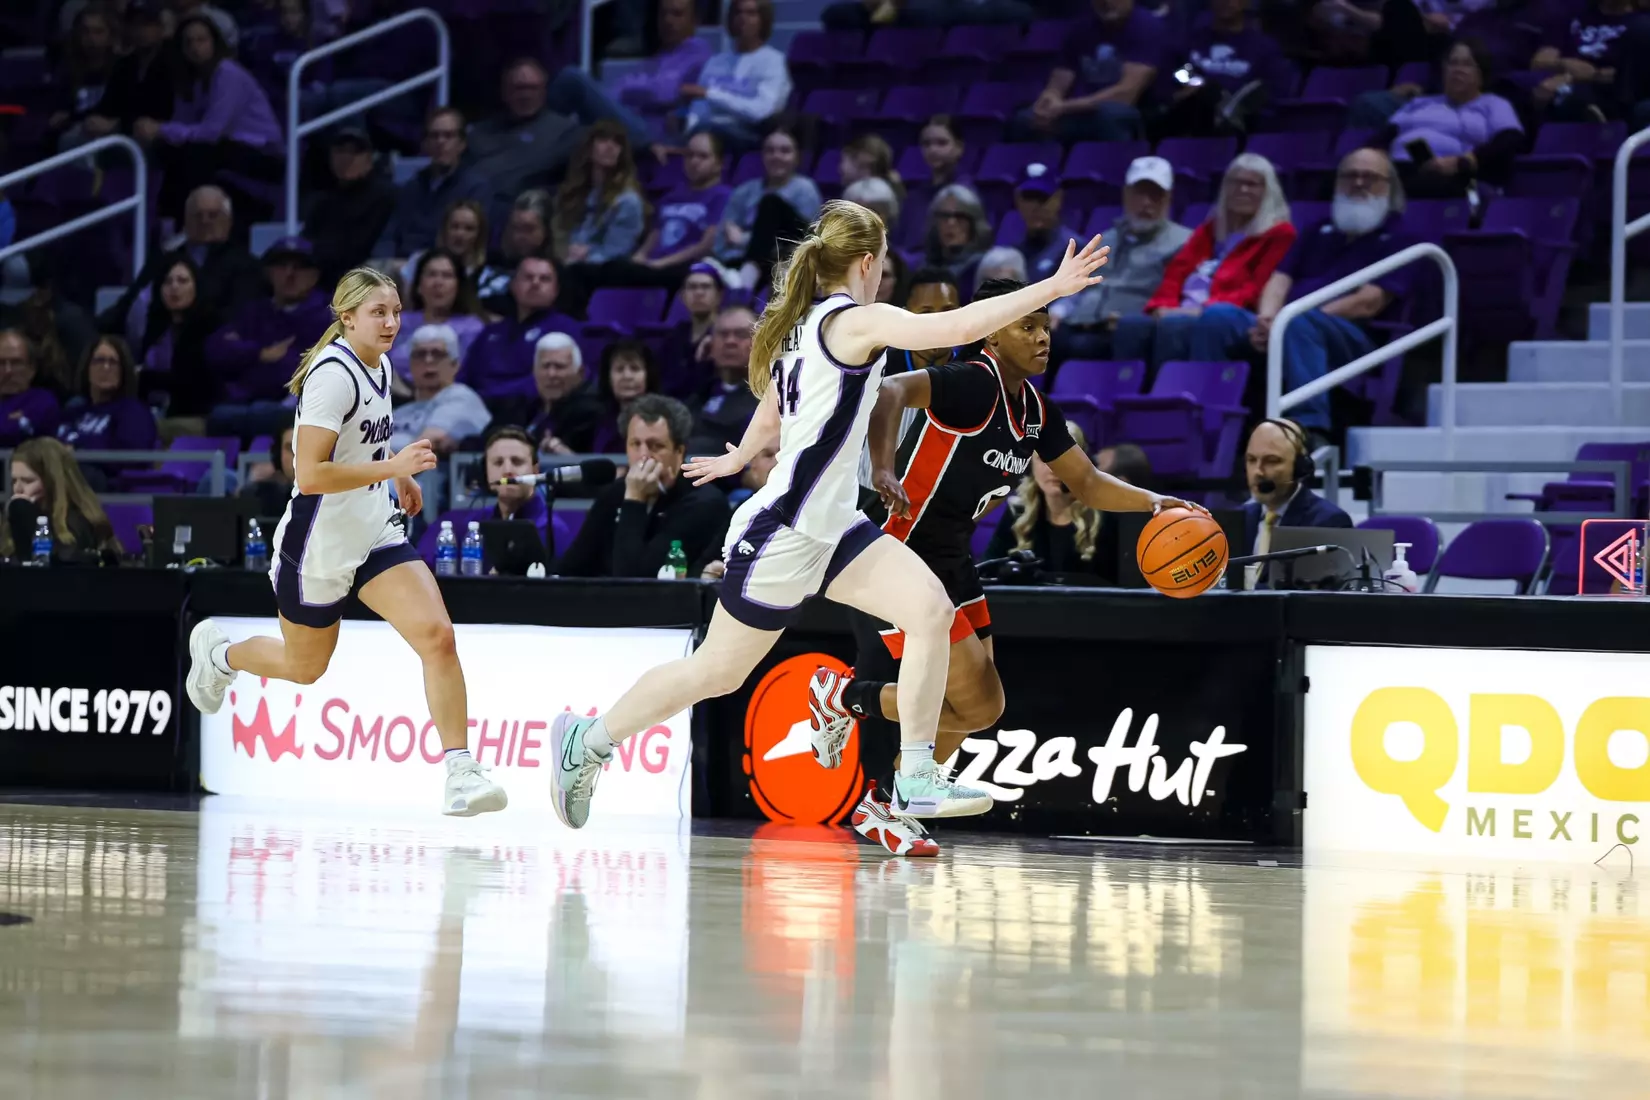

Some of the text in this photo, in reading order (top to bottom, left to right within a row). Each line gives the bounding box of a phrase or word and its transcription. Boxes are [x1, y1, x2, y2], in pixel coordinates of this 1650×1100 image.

[772, 357, 805, 418] 34
[0, 685, 172, 735] SINCE 1979
[314, 697, 547, 769] SMOOHIE
[1087, 706, 1249, 807] Hut
[1465, 806, 1641, 845] MEXIC
